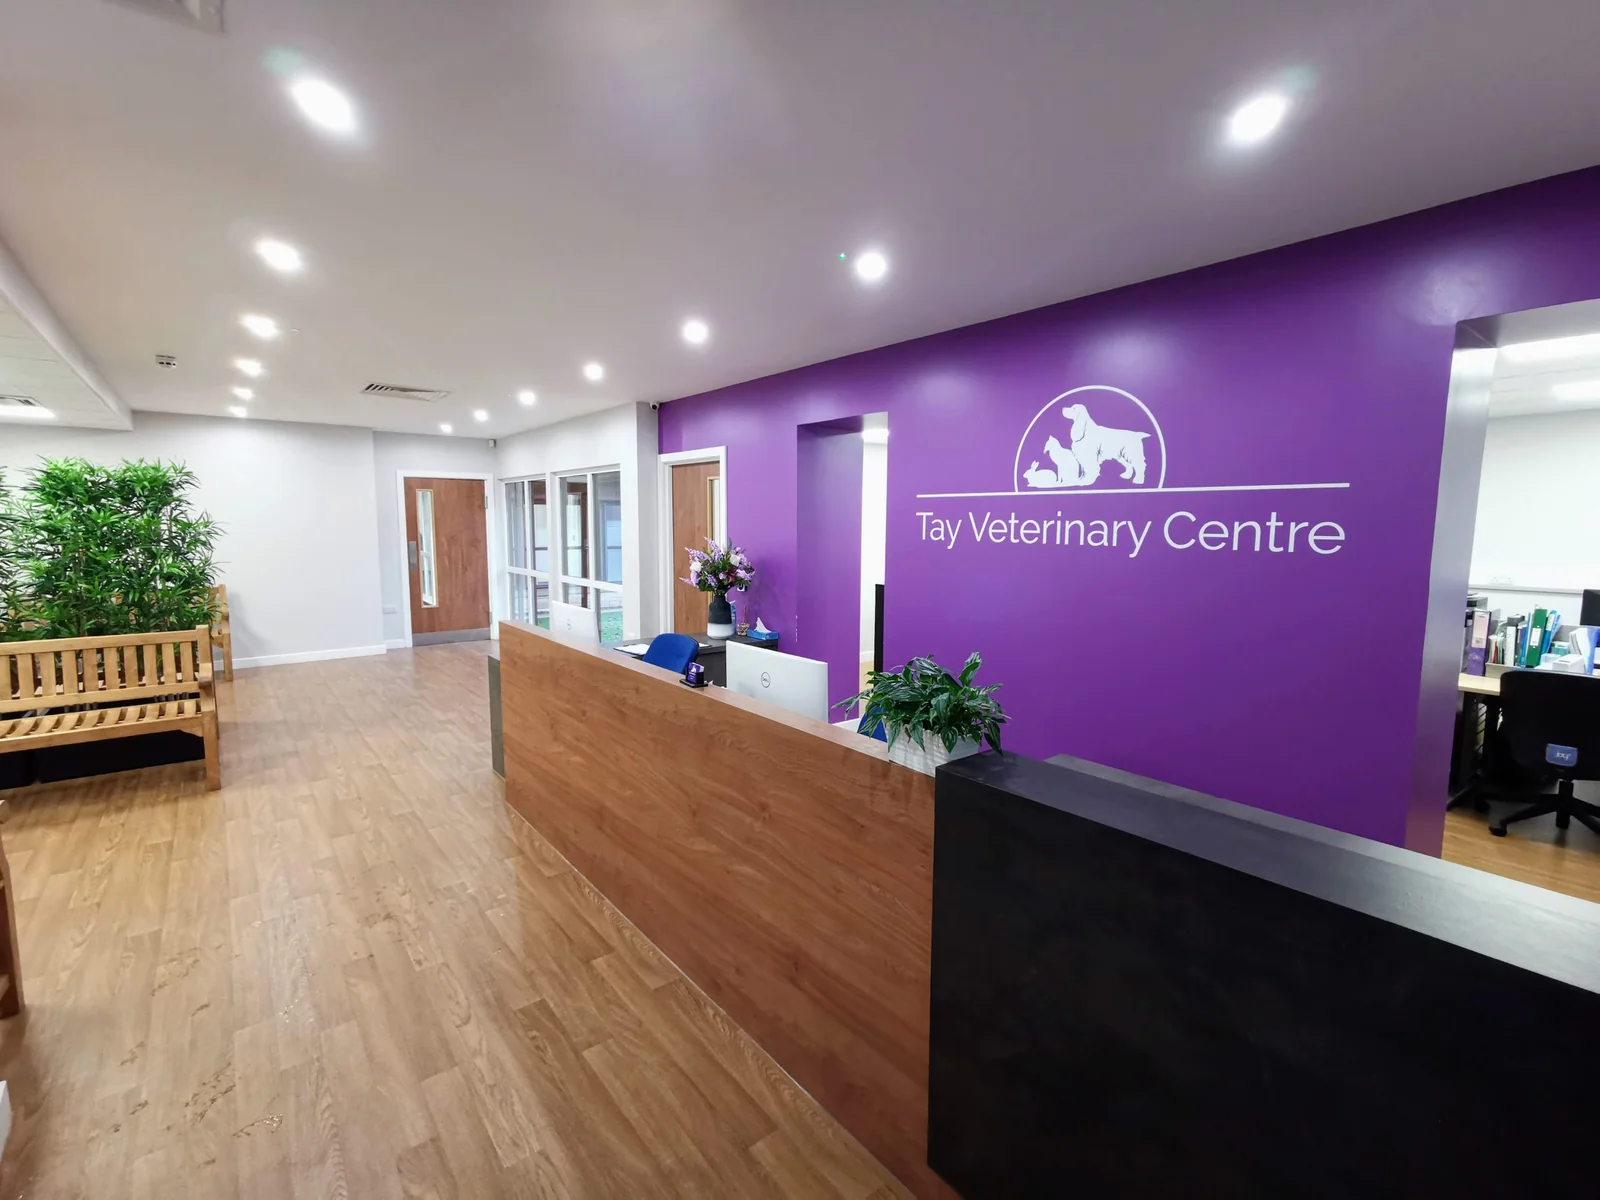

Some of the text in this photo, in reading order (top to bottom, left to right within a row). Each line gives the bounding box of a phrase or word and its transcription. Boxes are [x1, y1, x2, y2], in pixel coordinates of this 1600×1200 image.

[915, 510, 1346, 559] Tay Veterinary Centre
